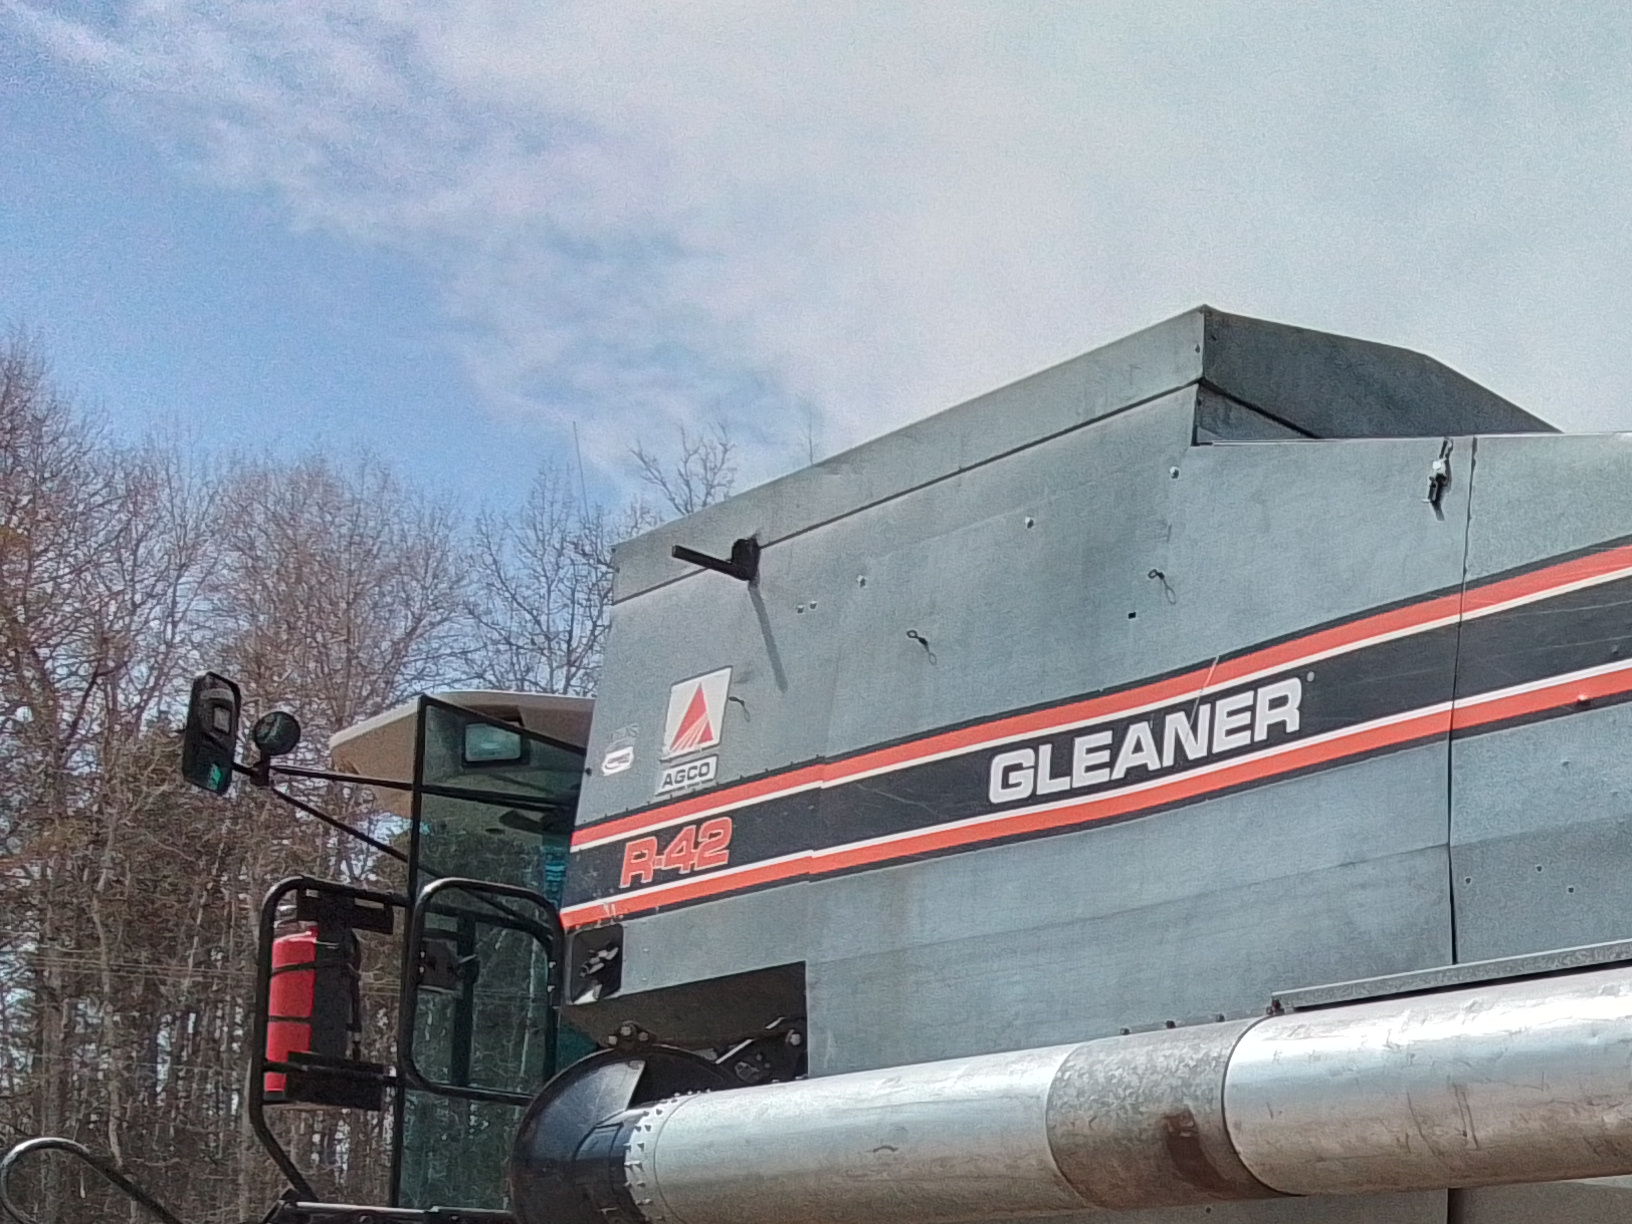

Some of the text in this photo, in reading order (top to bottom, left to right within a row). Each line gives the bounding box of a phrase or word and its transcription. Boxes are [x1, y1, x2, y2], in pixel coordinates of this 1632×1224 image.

[661, 761, 711, 789] AGCO
[988, 677, 1302, 804] GLEANER
[618, 816, 733, 889] R-42
